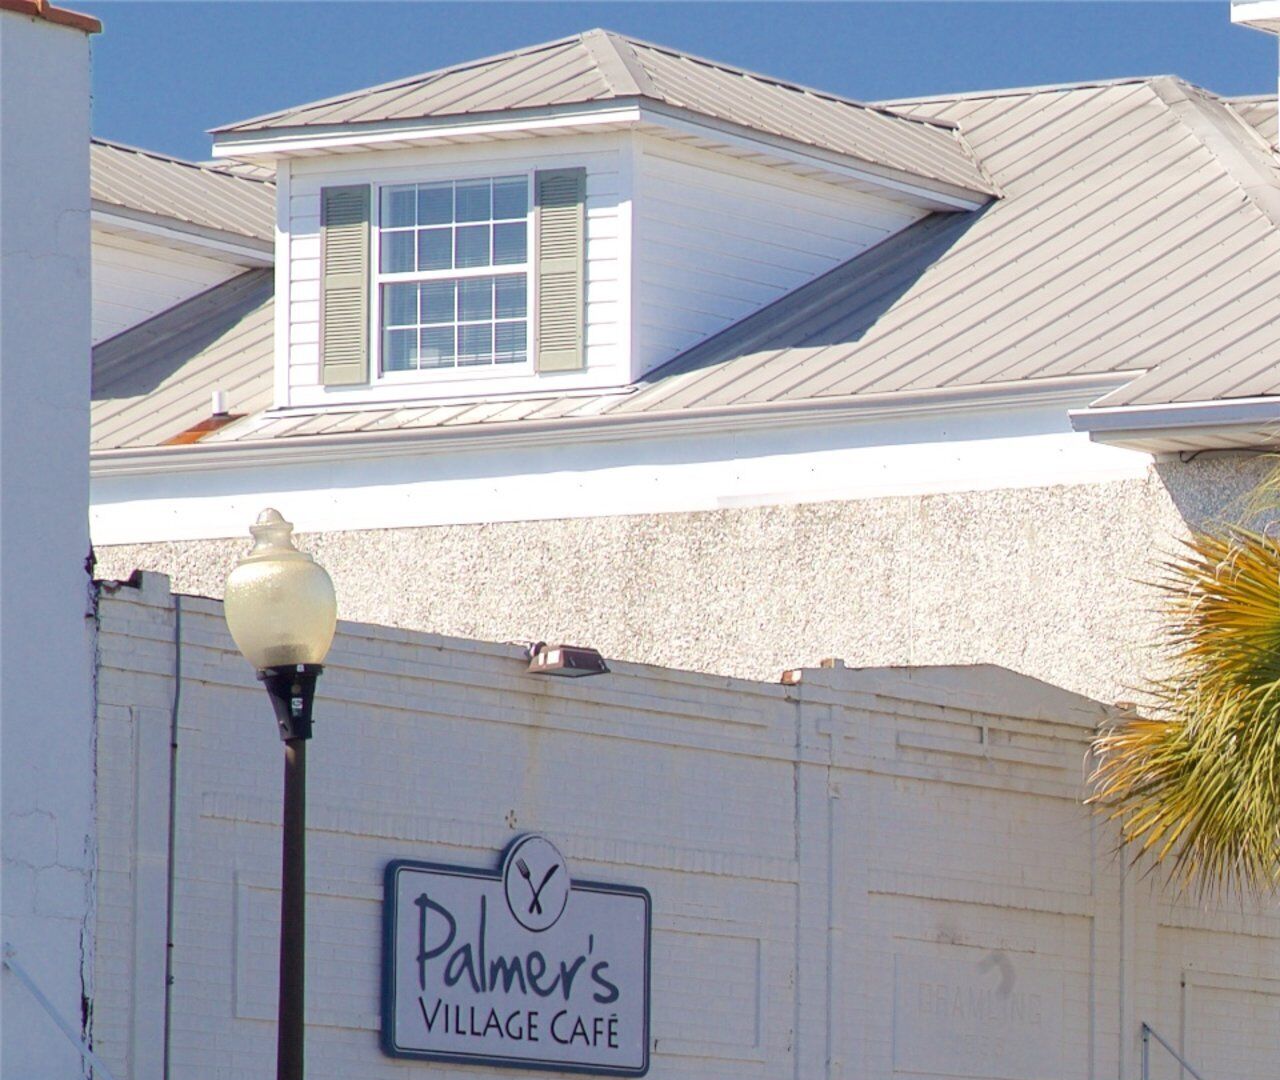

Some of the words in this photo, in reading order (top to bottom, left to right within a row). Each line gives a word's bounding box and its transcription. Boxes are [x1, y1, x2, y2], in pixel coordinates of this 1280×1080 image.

[414, 892, 620, 1005] Palmer's
[418, 996, 540, 1042] VILLAGE
[550, 1009, 619, 1049] CAFÉ
